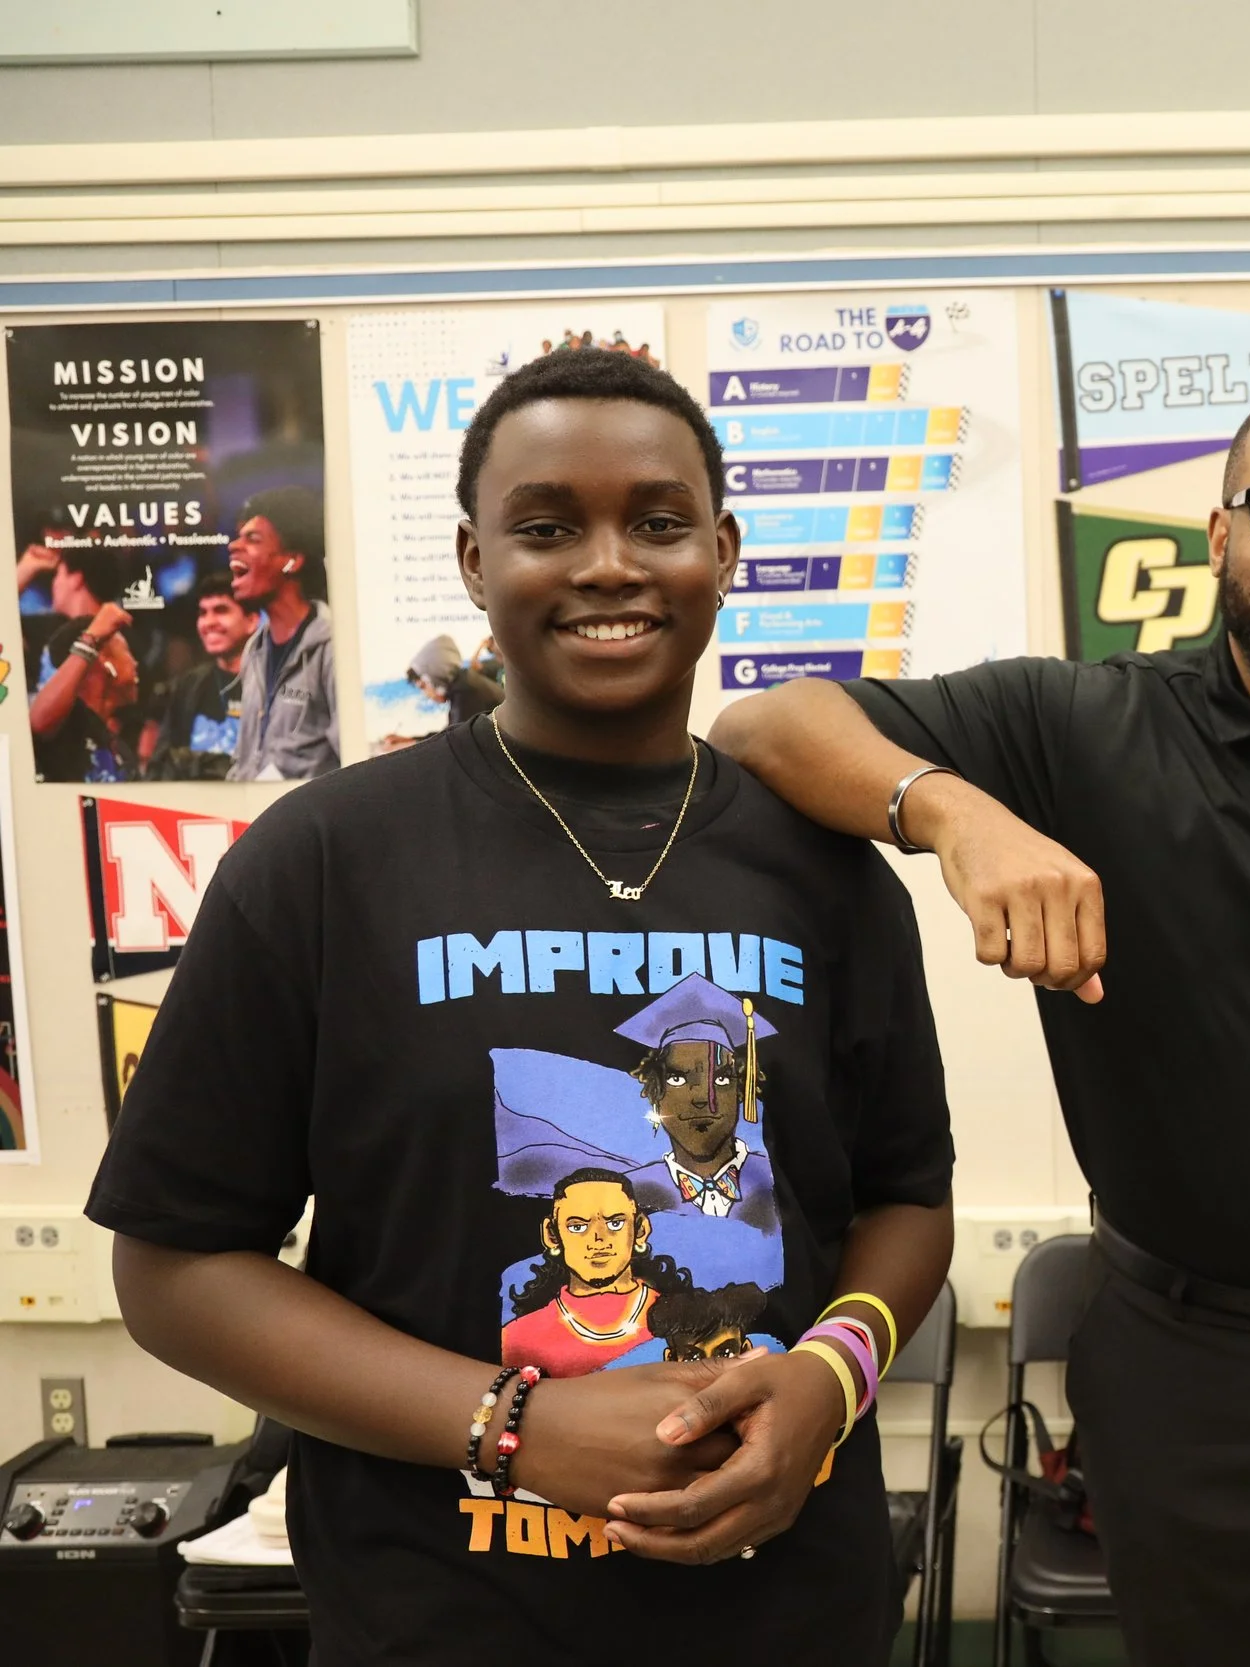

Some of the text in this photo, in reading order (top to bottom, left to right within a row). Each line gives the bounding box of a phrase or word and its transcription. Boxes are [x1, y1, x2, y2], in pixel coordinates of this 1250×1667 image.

[836, 308, 876, 327] THE
[780, 331, 884, 353] ROAD TO
[54, 358, 204, 386] MISSION
[723, 376, 747, 401] A
[374, 377, 475, 434] WE
[71, 421, 197, 447] VISION
[726, 420, 744, 445] B
[726, 465, 747, 491] C
[68, 501, 202, 528] VALUES
[103, 534, 157, 547] Authentic
[168, 532, 229, 546] Passionate
[733, 561, 749, 588] E
[736, 611, 750, 635] F
[734, 659, 758, 685] G
[104, 820, 233, 951] N
[609, 880, 641, 900] Leo
[417, 930, 804, 1005] IMPROVE
[459, 1498, 627, 1559] TOM
